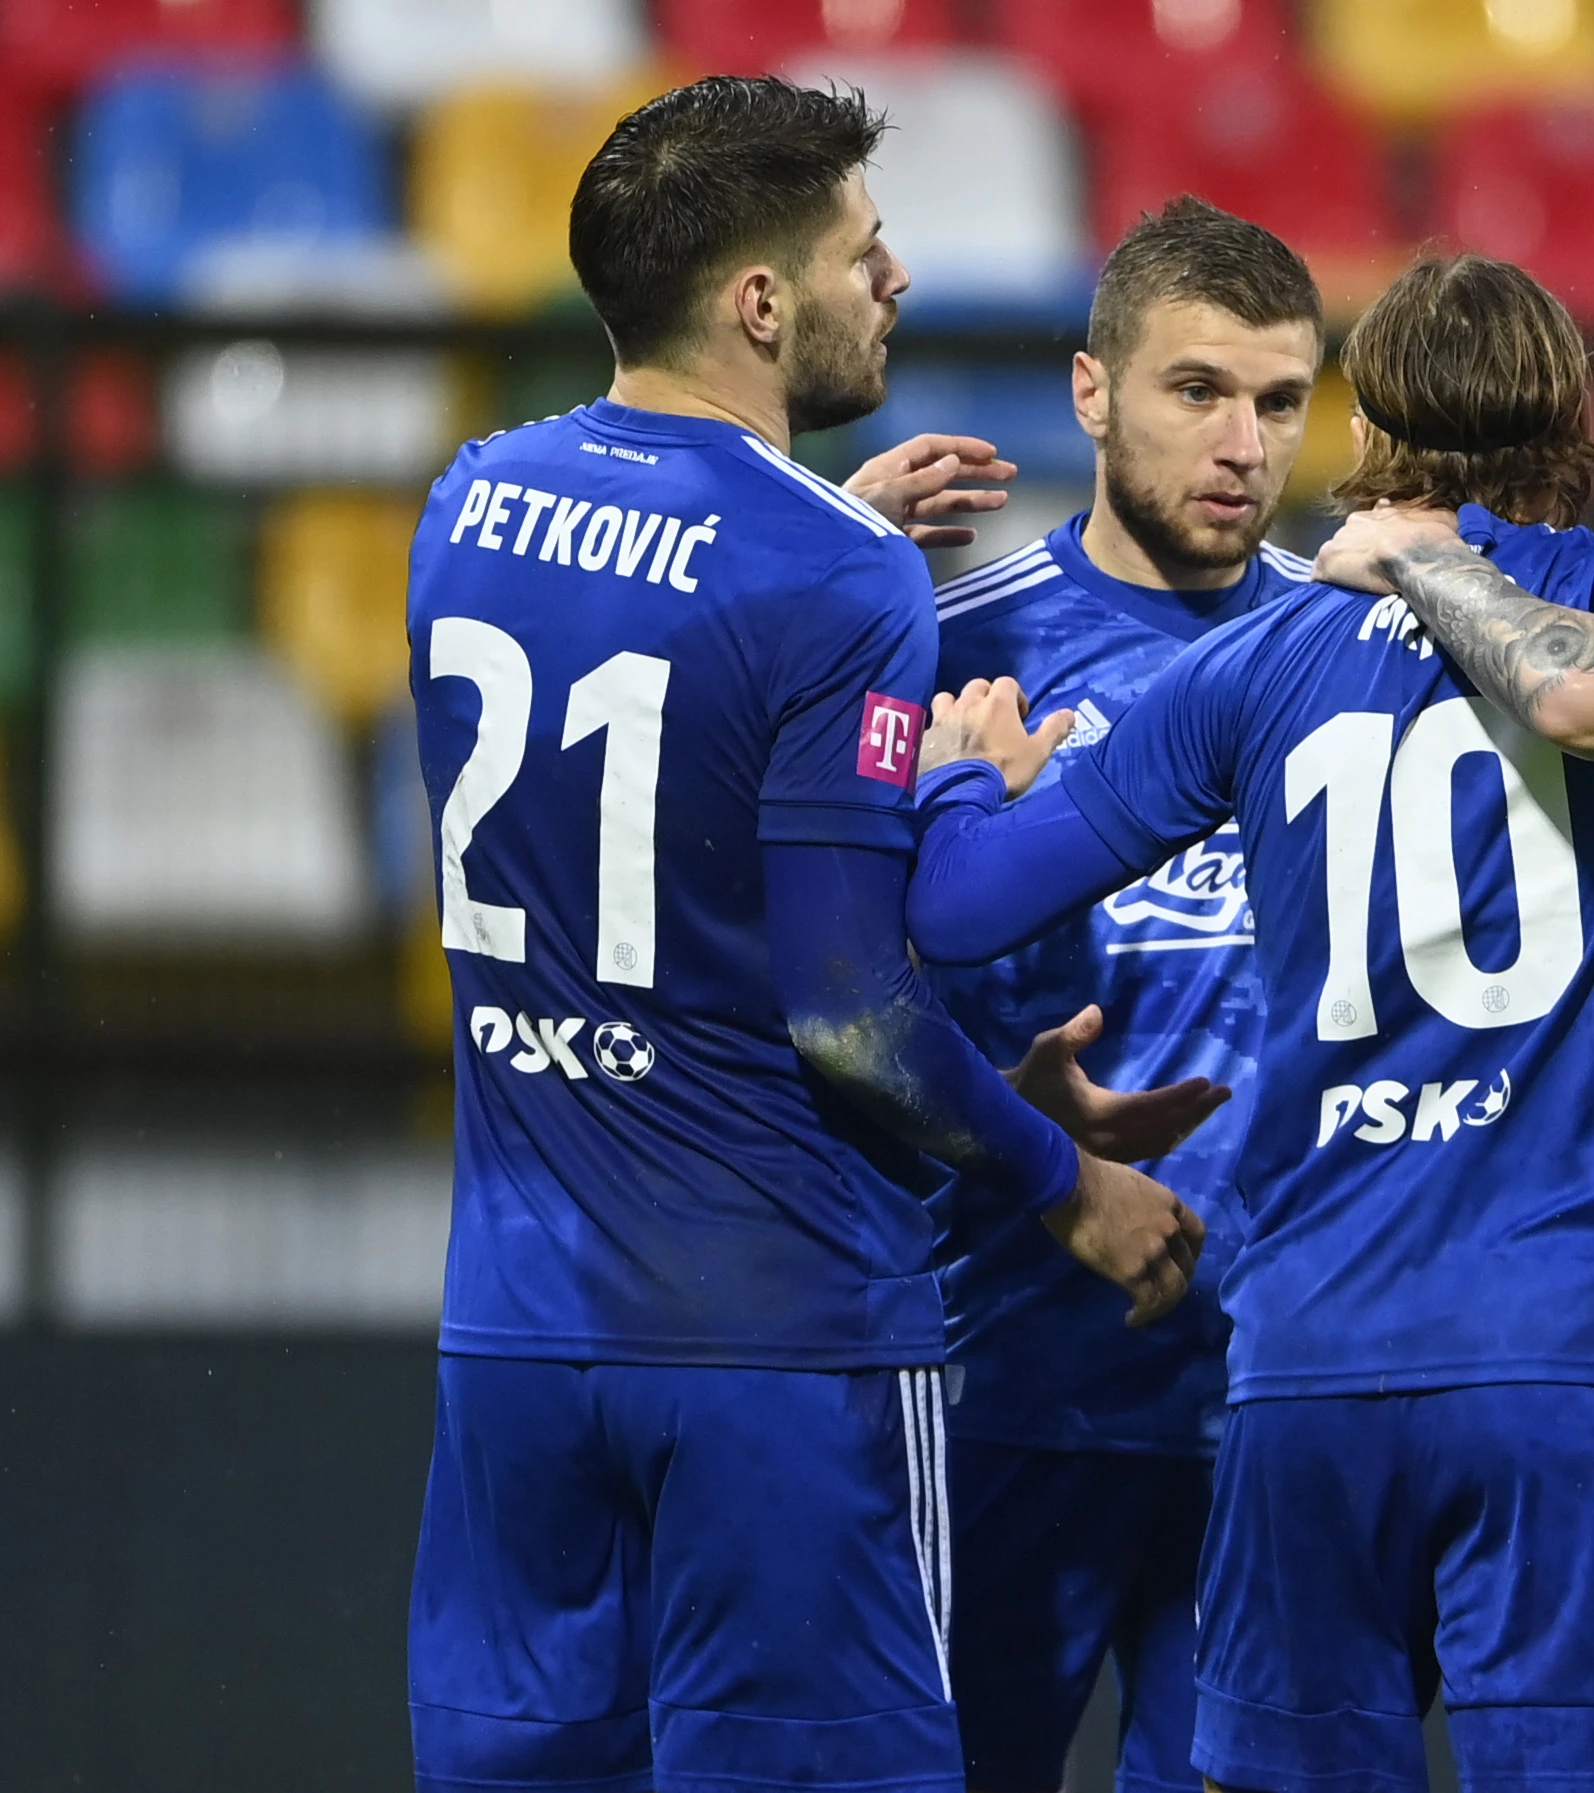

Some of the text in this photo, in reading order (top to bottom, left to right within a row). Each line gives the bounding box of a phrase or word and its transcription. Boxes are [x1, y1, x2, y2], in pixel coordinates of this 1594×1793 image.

[449, 479, 721, 593] PETKOVIĆ
[870, 705, 911, 772] T
[429, 616, 671, 989] 21
[1284, 696, 1584, 1042] 10
[1316, 1079, 1479, 1148] PSK
